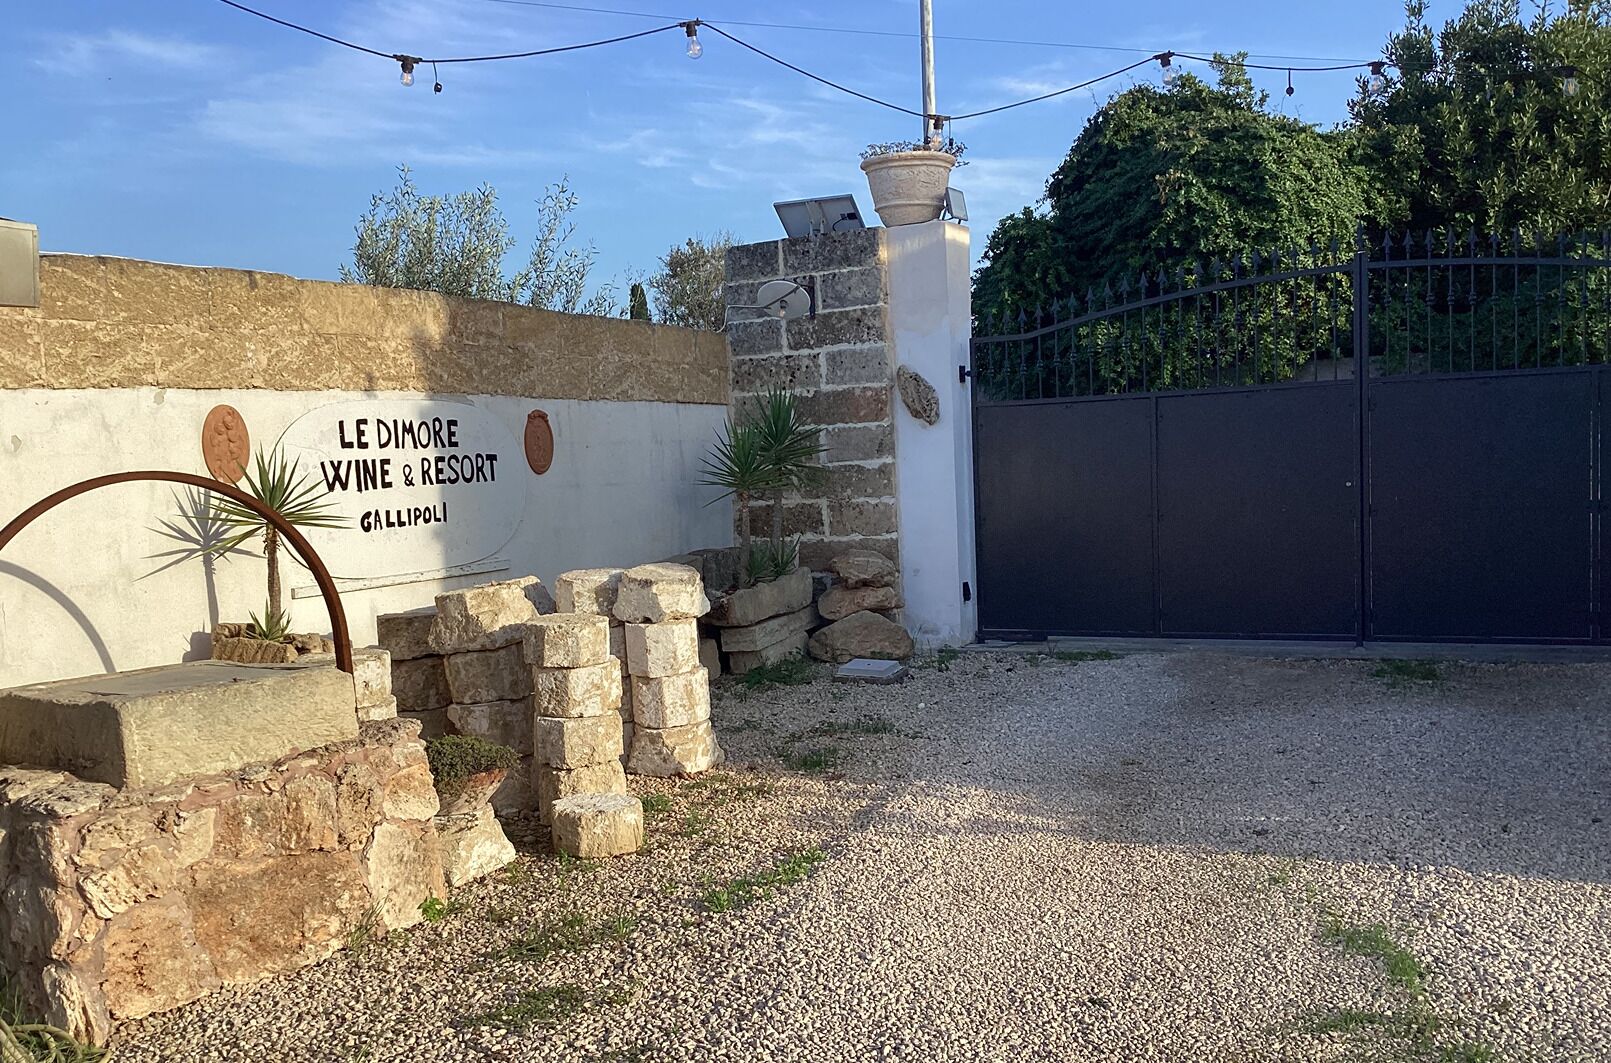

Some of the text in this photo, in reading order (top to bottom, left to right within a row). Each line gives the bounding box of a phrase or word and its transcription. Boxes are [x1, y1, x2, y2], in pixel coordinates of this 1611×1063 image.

[338, 416, 459, 449] LE DIMORE
[320, 453, 498, 493] WINE & RESORT
[360, 501, 447, 533] GALLIPOLI
